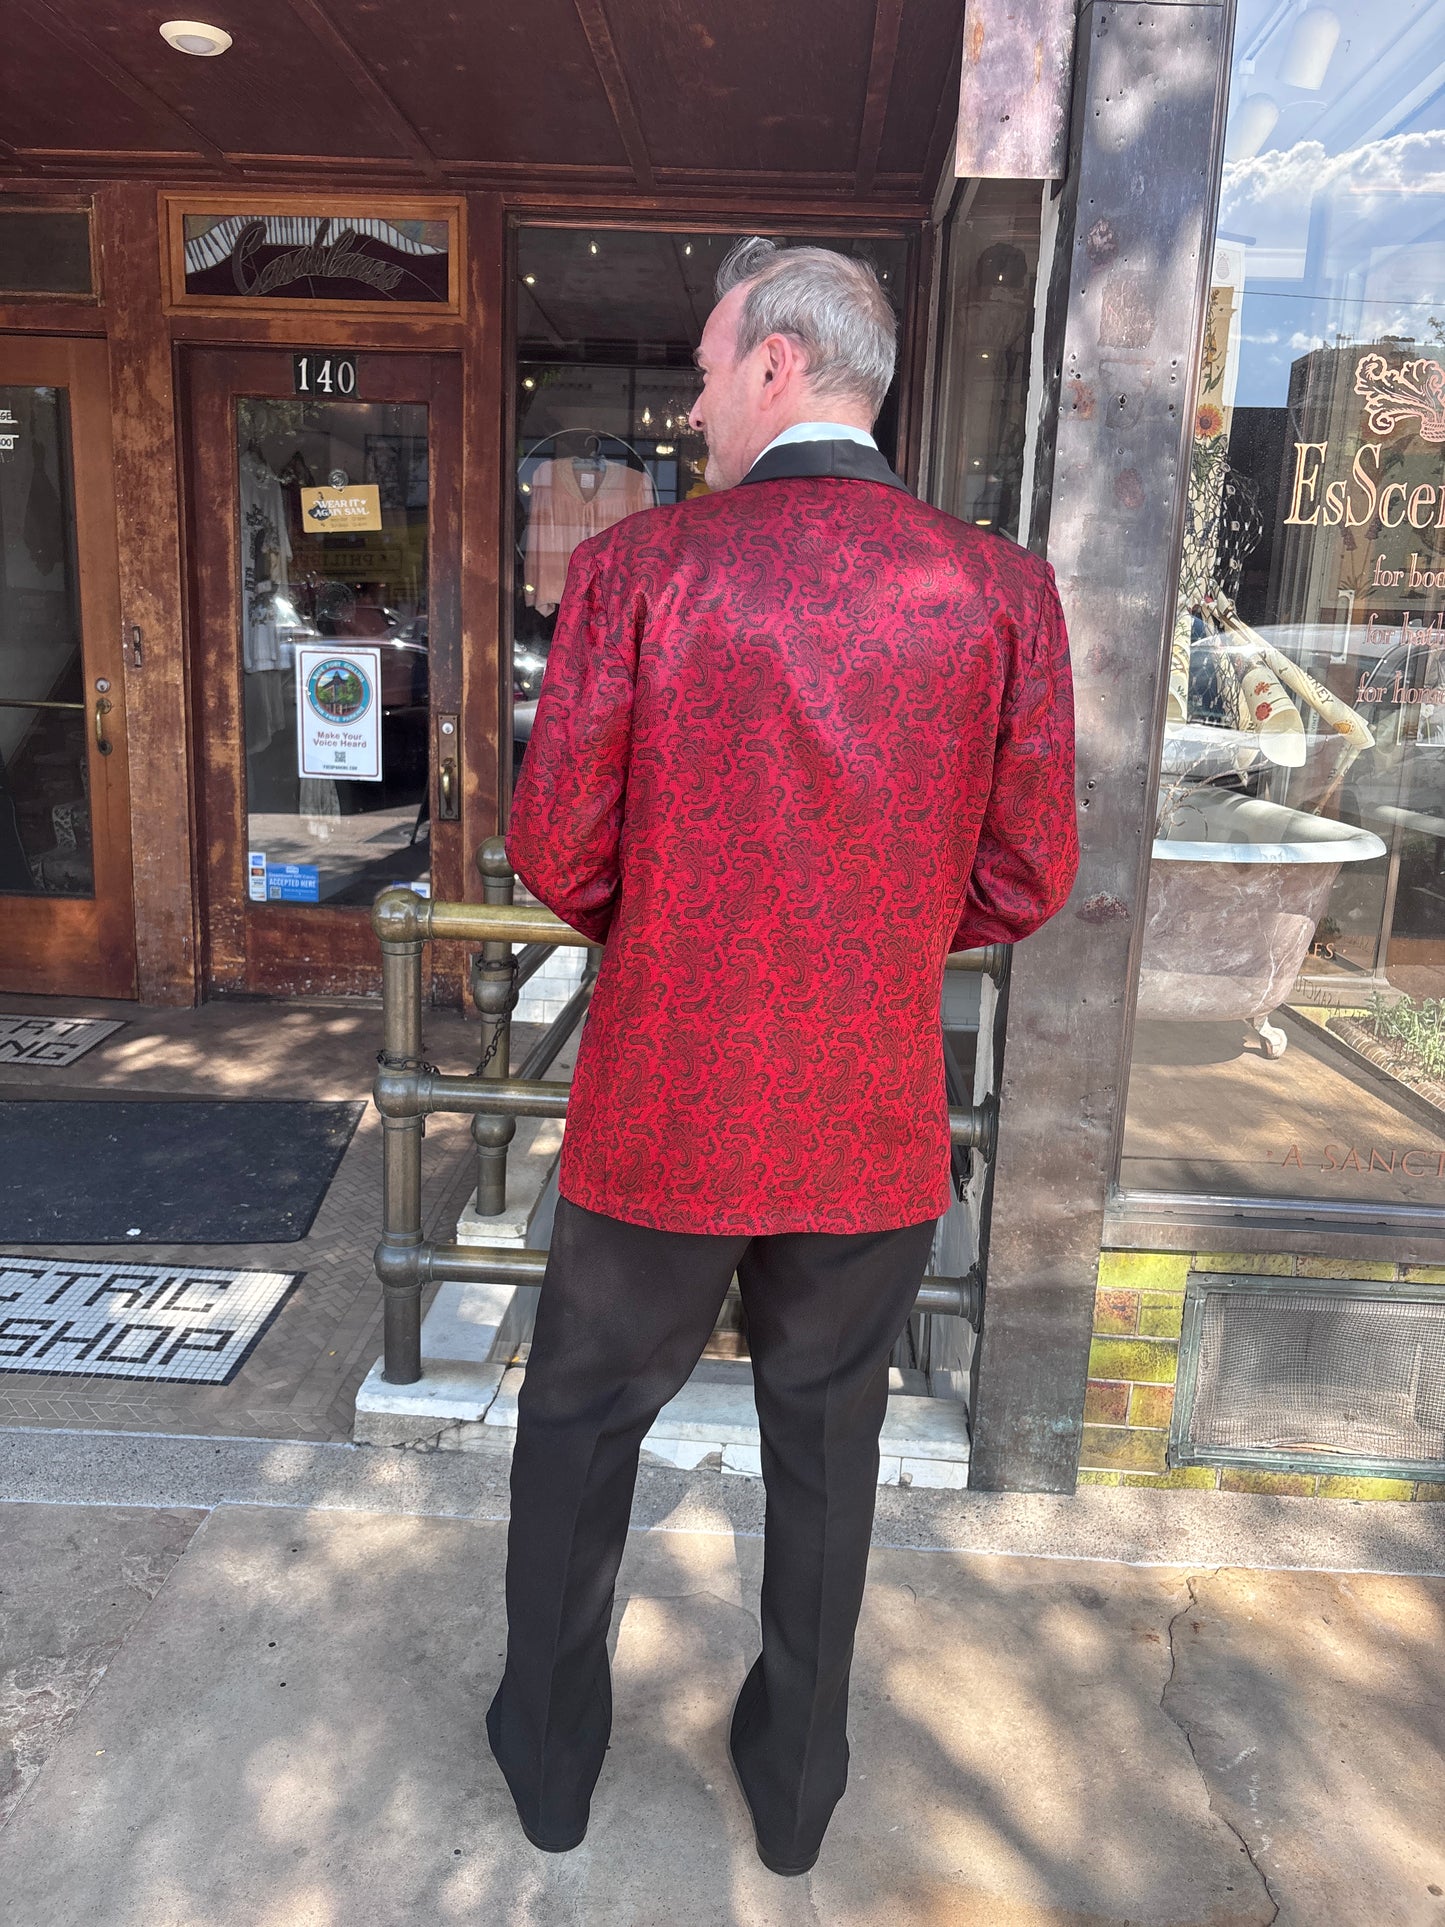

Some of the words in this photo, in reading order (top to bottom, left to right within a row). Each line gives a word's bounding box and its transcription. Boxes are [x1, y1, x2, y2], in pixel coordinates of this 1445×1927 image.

[298, 357, 355, 394] 140
[313, 499, 347, 509] WEAR
[349, 499, 360, 507] IT
[314, 507, 342, 518] AGAIN
[1372, 554, 1404, 587] for
[1364, 613, 1396, 645] for
[1357, 671, 1387, 703] for
[313, 739, 338, 747] Voice
[340, 740, 367, 748] Heard
[317, 731, 340, 740] Make
[342, 732, 363, 741] Your
[269, 878, 300, 887] ACCEPTED
[300, 880, 316, 888] HERE
[1305, 942, 1335, 959] ES
[1282, 1144, 1304, 1169] A
[0, 1318, 236, 1365] SHOP
